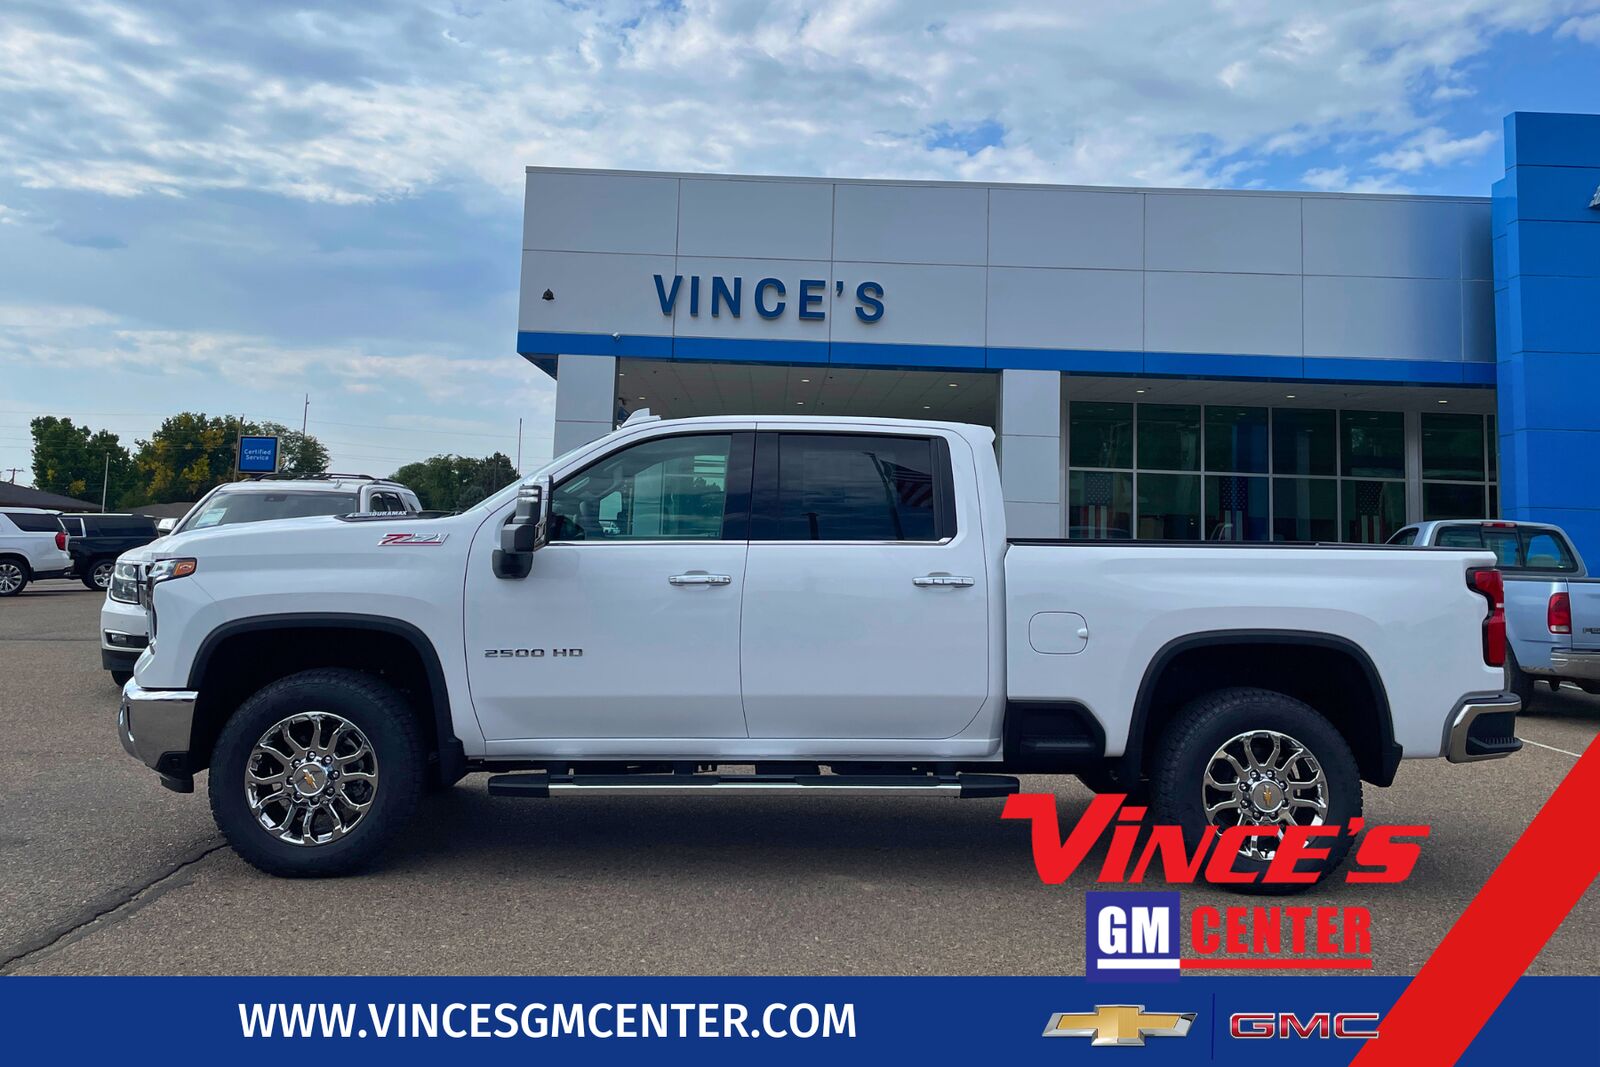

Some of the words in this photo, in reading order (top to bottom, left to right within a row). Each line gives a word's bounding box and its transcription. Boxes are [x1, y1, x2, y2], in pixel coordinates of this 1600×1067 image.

[653, 274, 885, 323] VINCE'S
[378, 533, 449, 546] Z71
[484, 649, 545, 658] 2500
[552, 648, 583, 657] HD
